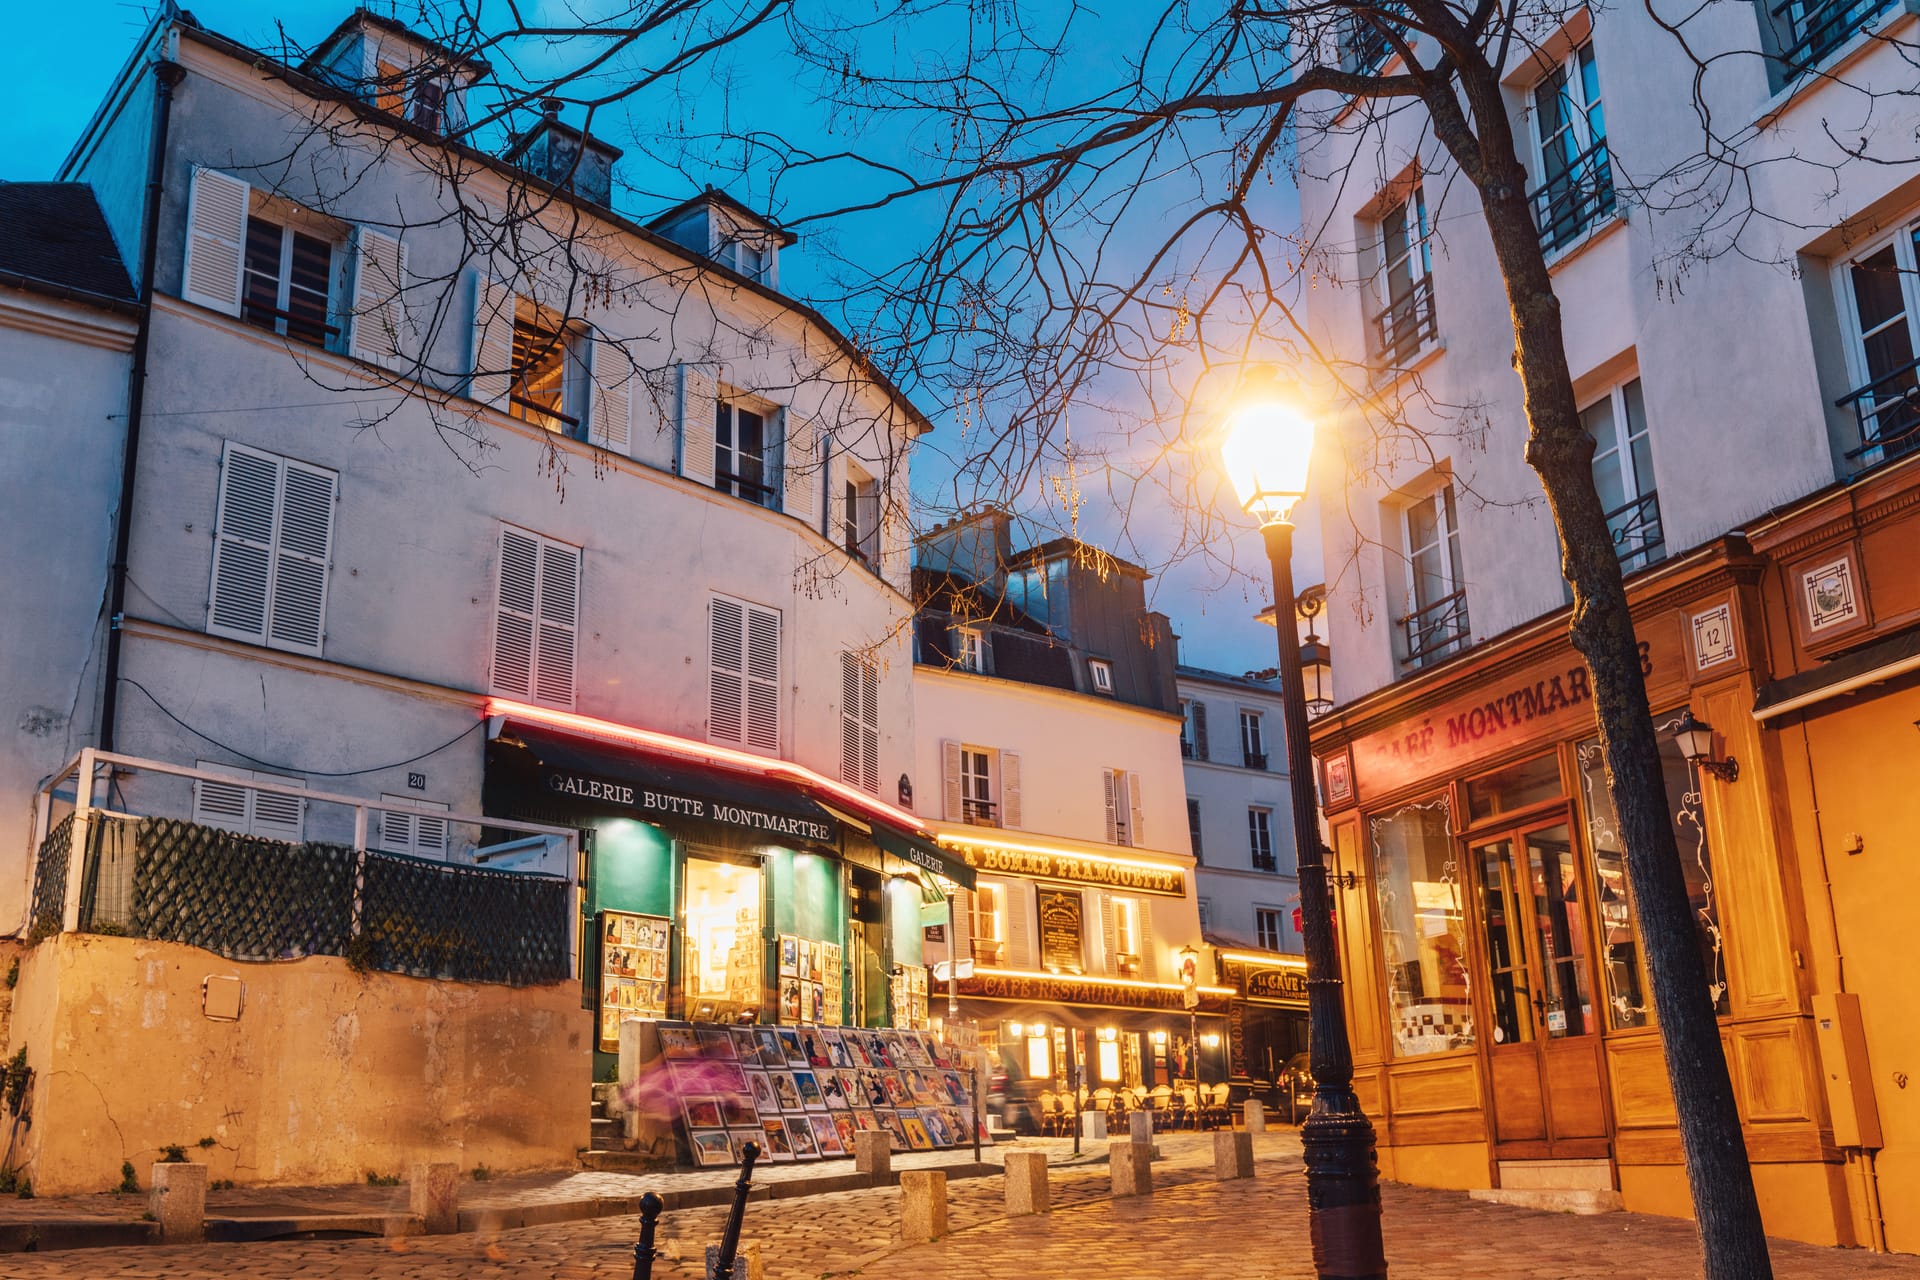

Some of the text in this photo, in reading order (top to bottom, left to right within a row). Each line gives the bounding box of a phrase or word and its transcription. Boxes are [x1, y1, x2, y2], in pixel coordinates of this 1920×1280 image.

[1706, 627, 1721, 647] 12
[1445, 639, 1653, 748] MONTMARE
[410, 774, 424, 787] 20
[549, 773, 830, 841] GALERIE BUTTE MONTMARTRE
[909, 846, 945, 875] GALERIE
[983, 847, 1051, 876] BONNE
[1055, 857, 1174, 891] FRANQUETTE
[1038, 979, 1150, 1007] RESTAURANT
[1257, 975, 1267, 986] LA
[1267, 975, 1299, 991] CAVE
